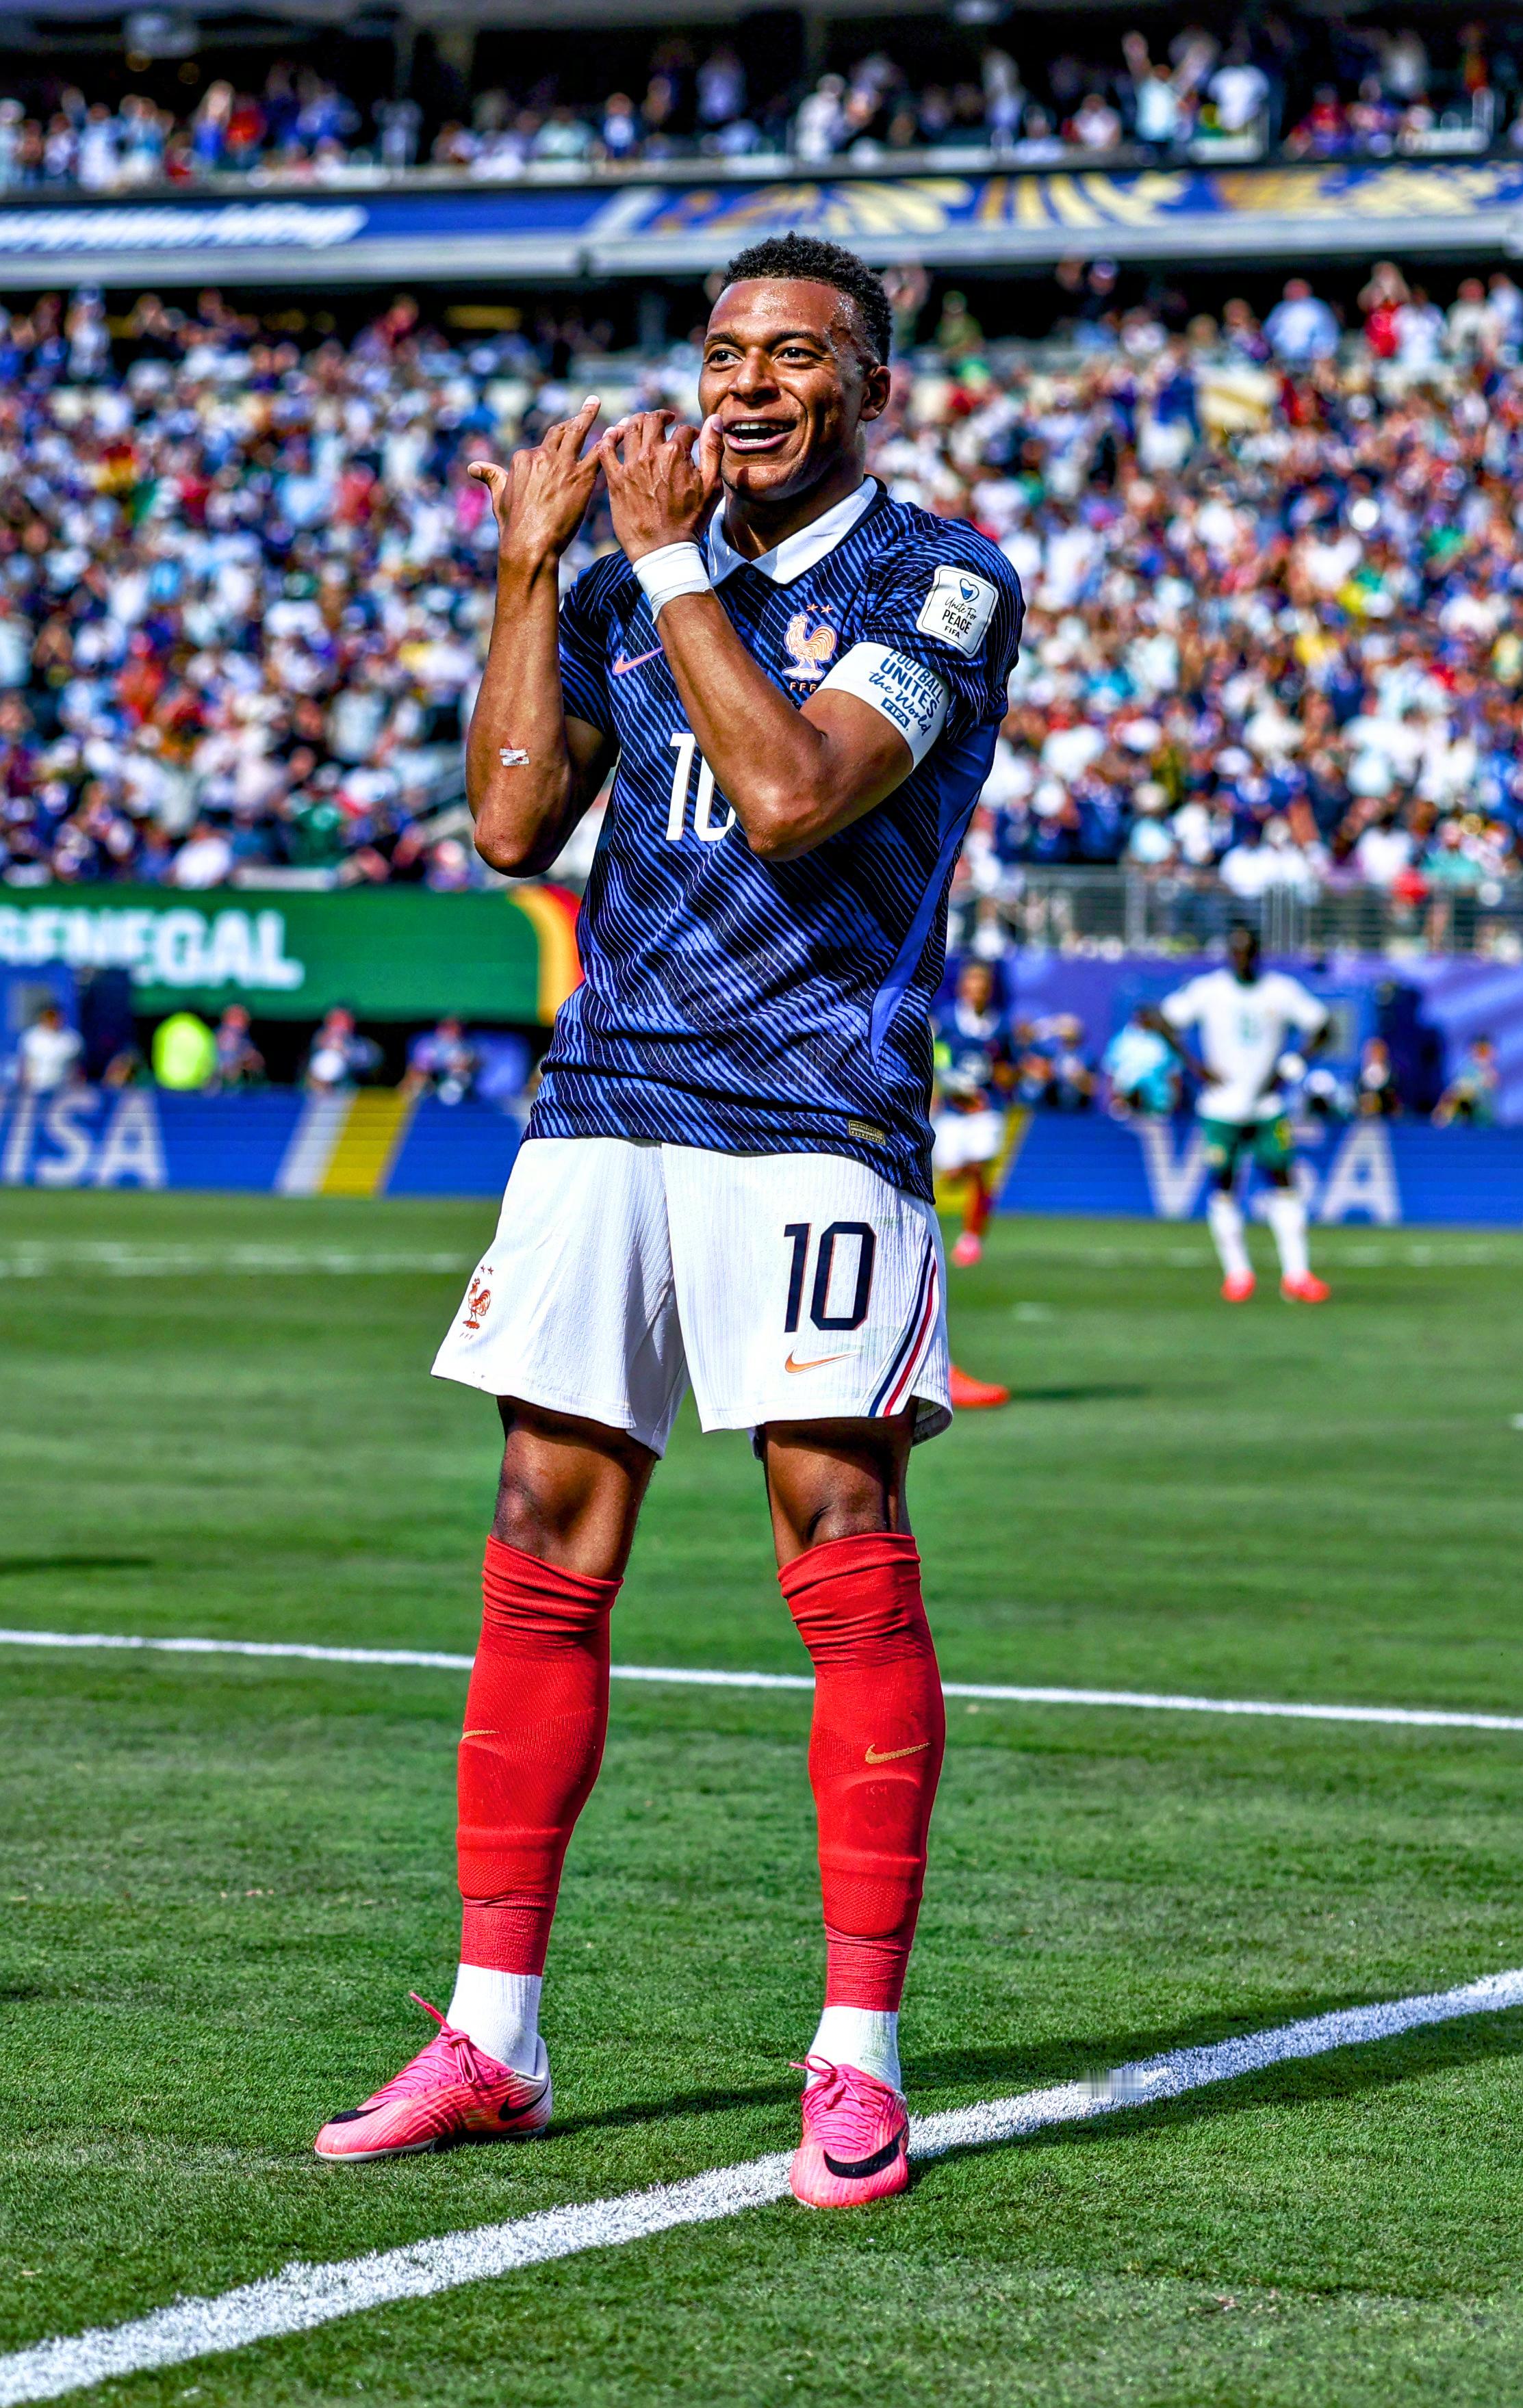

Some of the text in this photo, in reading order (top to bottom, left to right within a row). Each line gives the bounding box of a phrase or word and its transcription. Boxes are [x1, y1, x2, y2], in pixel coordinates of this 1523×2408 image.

[941, 609, 973, 635] PEACE
[944, 625, 960, 639] FIFA
[945, 596, 977, 620] Unite For
[868, 671, 932, 736] the World
[880, 657, 938, 718] UNITES
[889, 649, 944, 704] FOOTBALL
[882, 699, 908, 727] FIFA
[0, 1091, 168, 1189] ISA
[783, 1221, 878, 1333] 10
